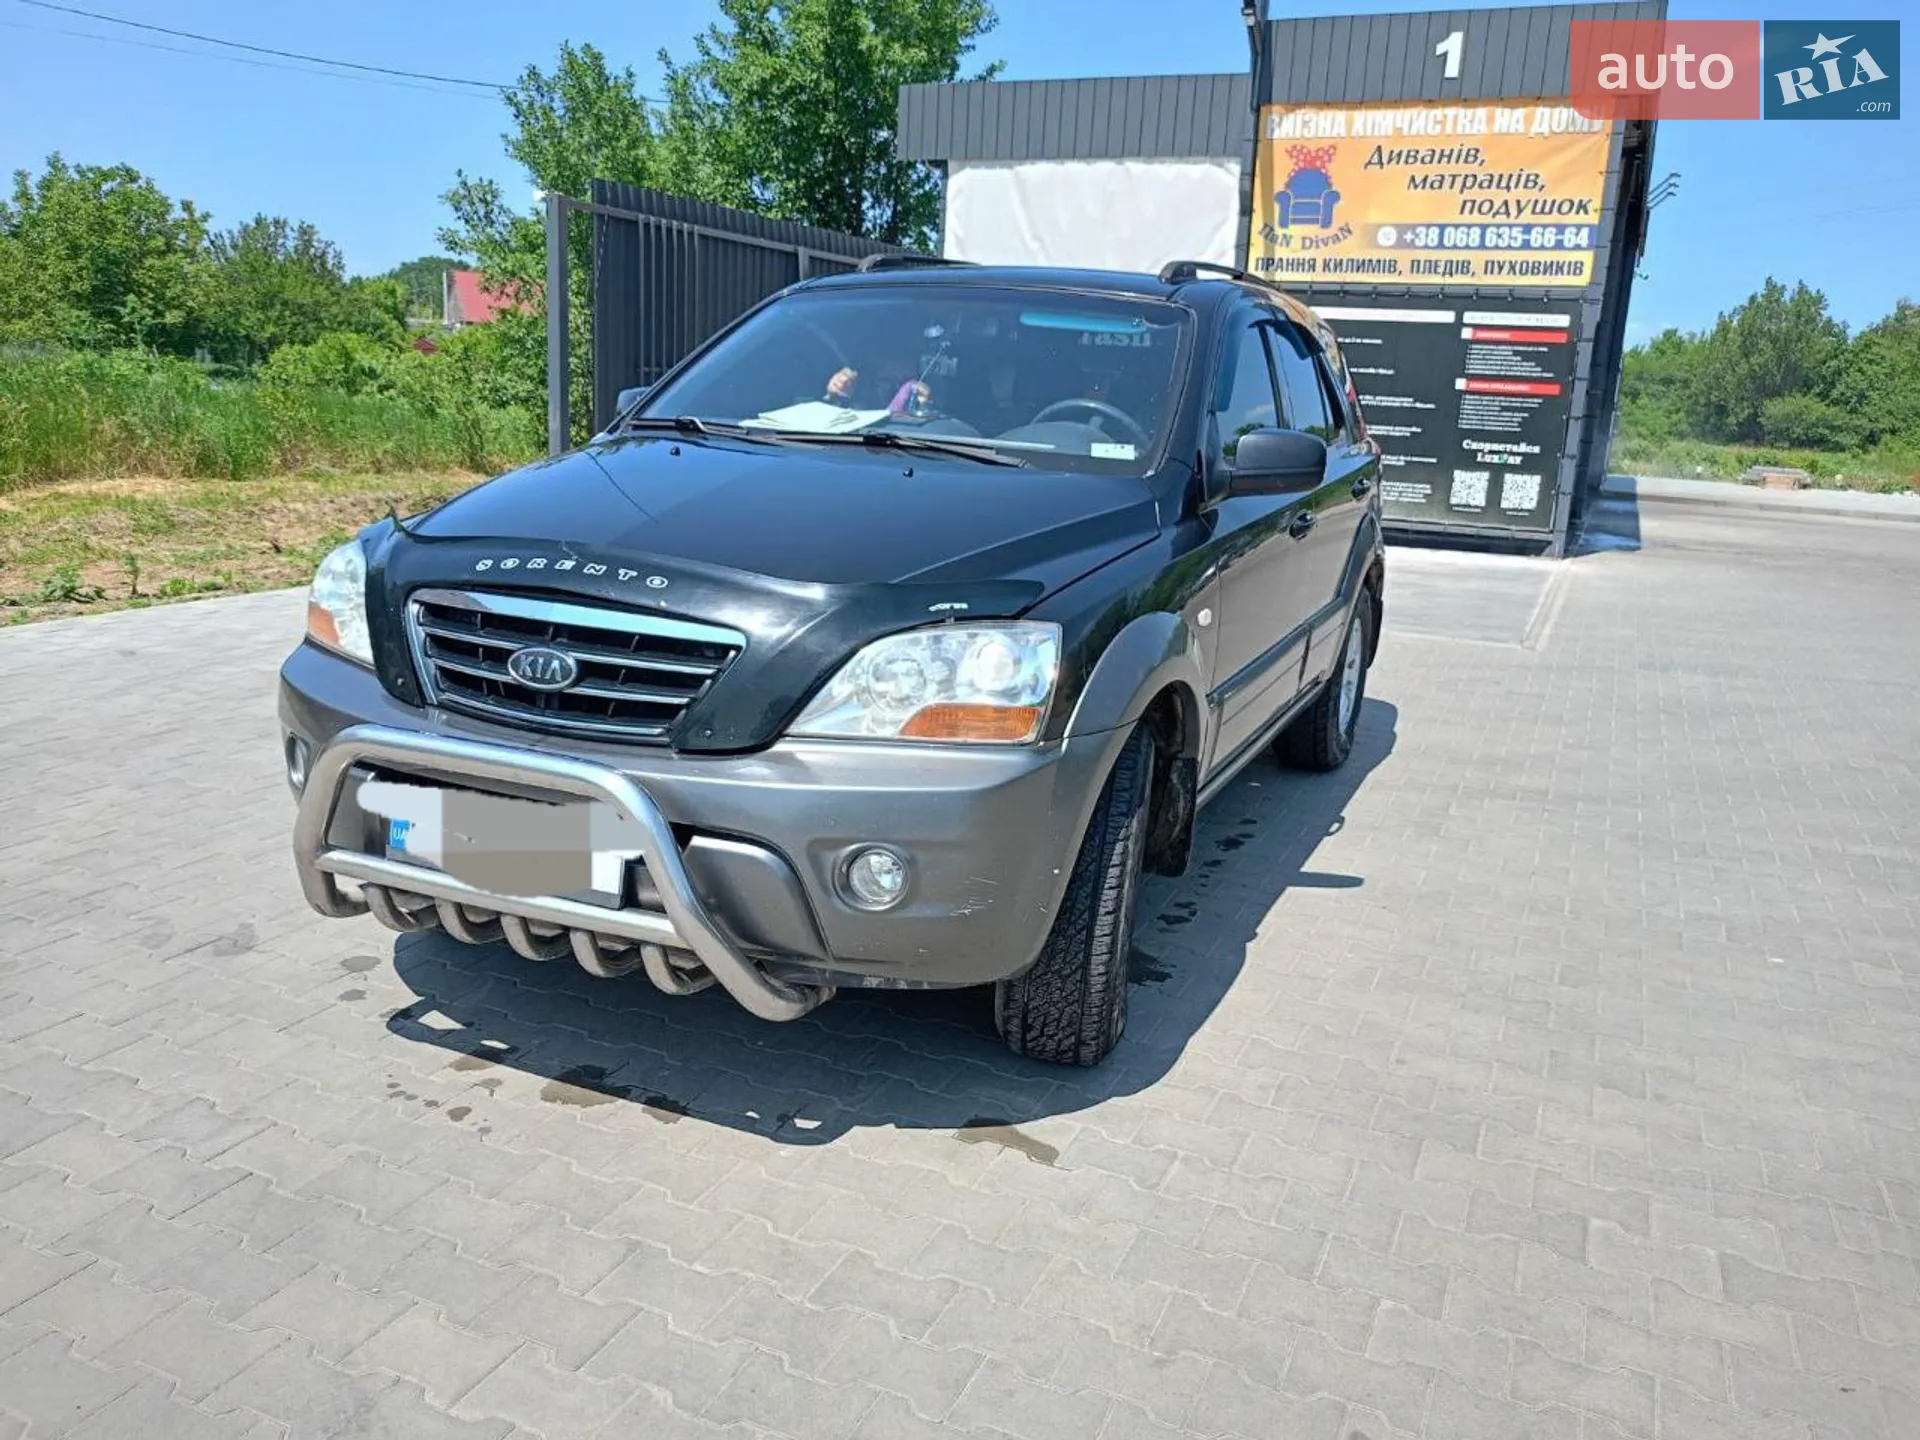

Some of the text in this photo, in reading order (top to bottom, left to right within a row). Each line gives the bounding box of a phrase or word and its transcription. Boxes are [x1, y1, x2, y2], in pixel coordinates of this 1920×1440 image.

[1434, 31, 1465, 79] 1
[1494, 106, 1526, 134] НА
[1364, 143, 1486, 169] Диванів,
[1407, 168, 1546, 193] матраців,
[1459, 198, 1593, 220] подушок
[1403, 226, 1590, 249] +38 068 635-66-64
[1255, 257, 1584, 278] ПРАННЯ КИЛИМІВ, ПЛЕДІВ, ПУХОВИКІВ
[475, 558, 669, 588] SORENTO
[518, 656, 562, 681] KIA
